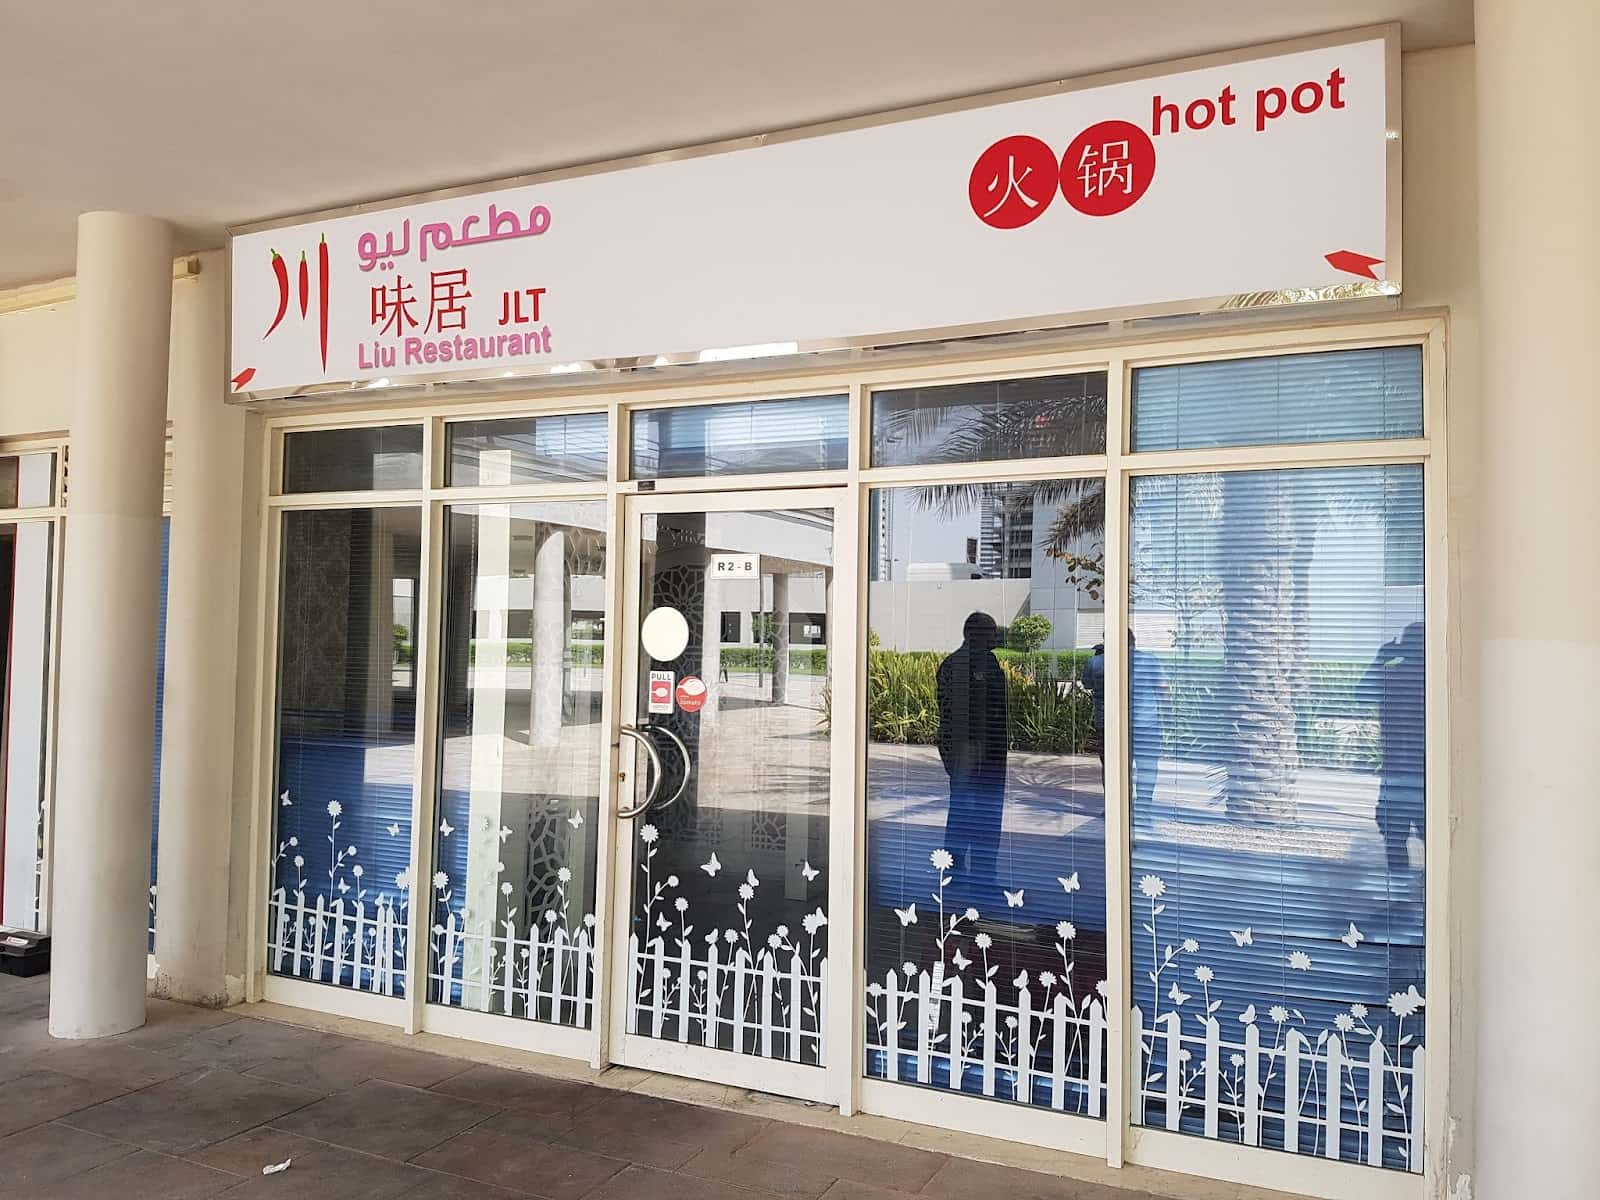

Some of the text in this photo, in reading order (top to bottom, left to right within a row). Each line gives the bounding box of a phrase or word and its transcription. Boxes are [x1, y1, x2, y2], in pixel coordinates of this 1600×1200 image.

[1151, 68, 1346, 136] hot pot
[983, 140, 1134, 218] 火锅
[357, 204, 551, 272] مطعم ليو
[370, 268, 473, 337] 味居
[498, 287, 547, 326] JLT
[358, 325, 552, 369] Liu Restaurant
[651, 673, 672, 681] PULL
